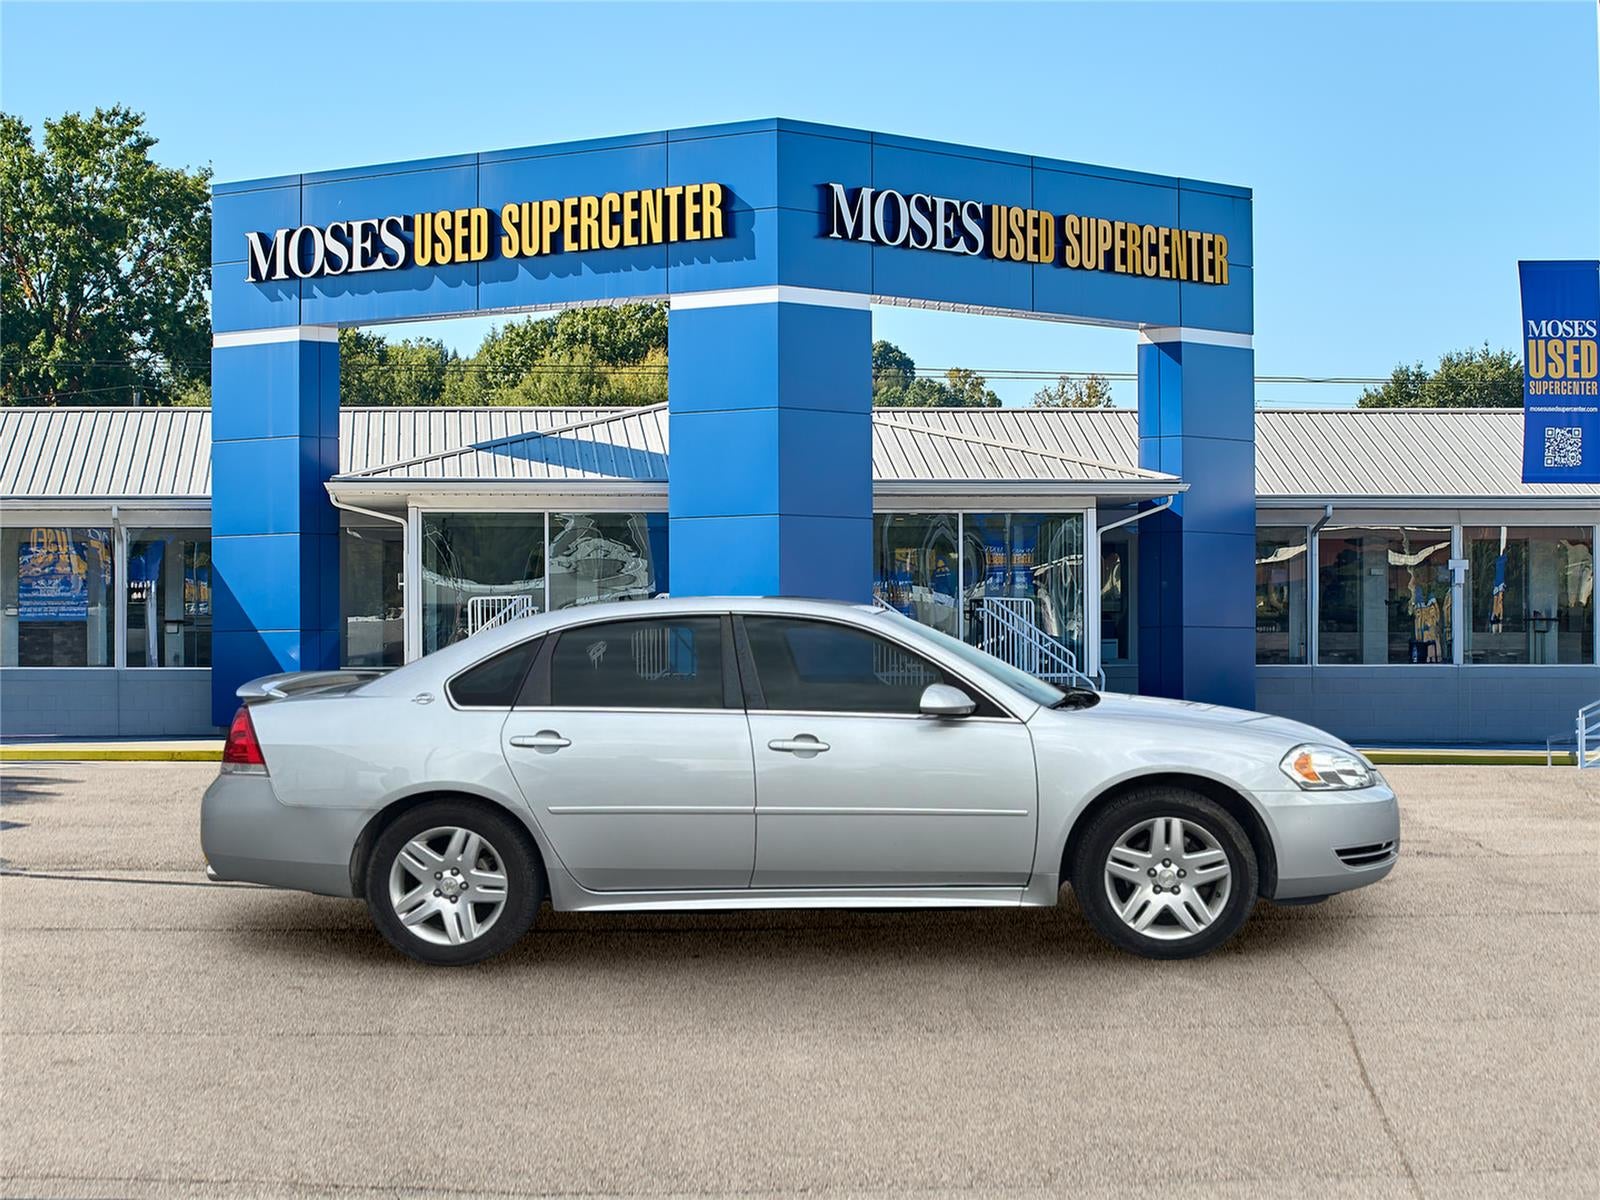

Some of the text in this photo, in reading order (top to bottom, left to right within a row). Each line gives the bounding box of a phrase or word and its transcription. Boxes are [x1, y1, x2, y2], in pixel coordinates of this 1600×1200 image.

[244, 182, 724, 284] MOSES USED SUPERCENTER
[829, 182, 1230, 286] MOSES USED SUPERCENTER
[1527, 320, 1597, 338] MOSES
[1528, 339, 1598, 379] USED
[1529, 380, 1598, 396] SUPERCENTER
